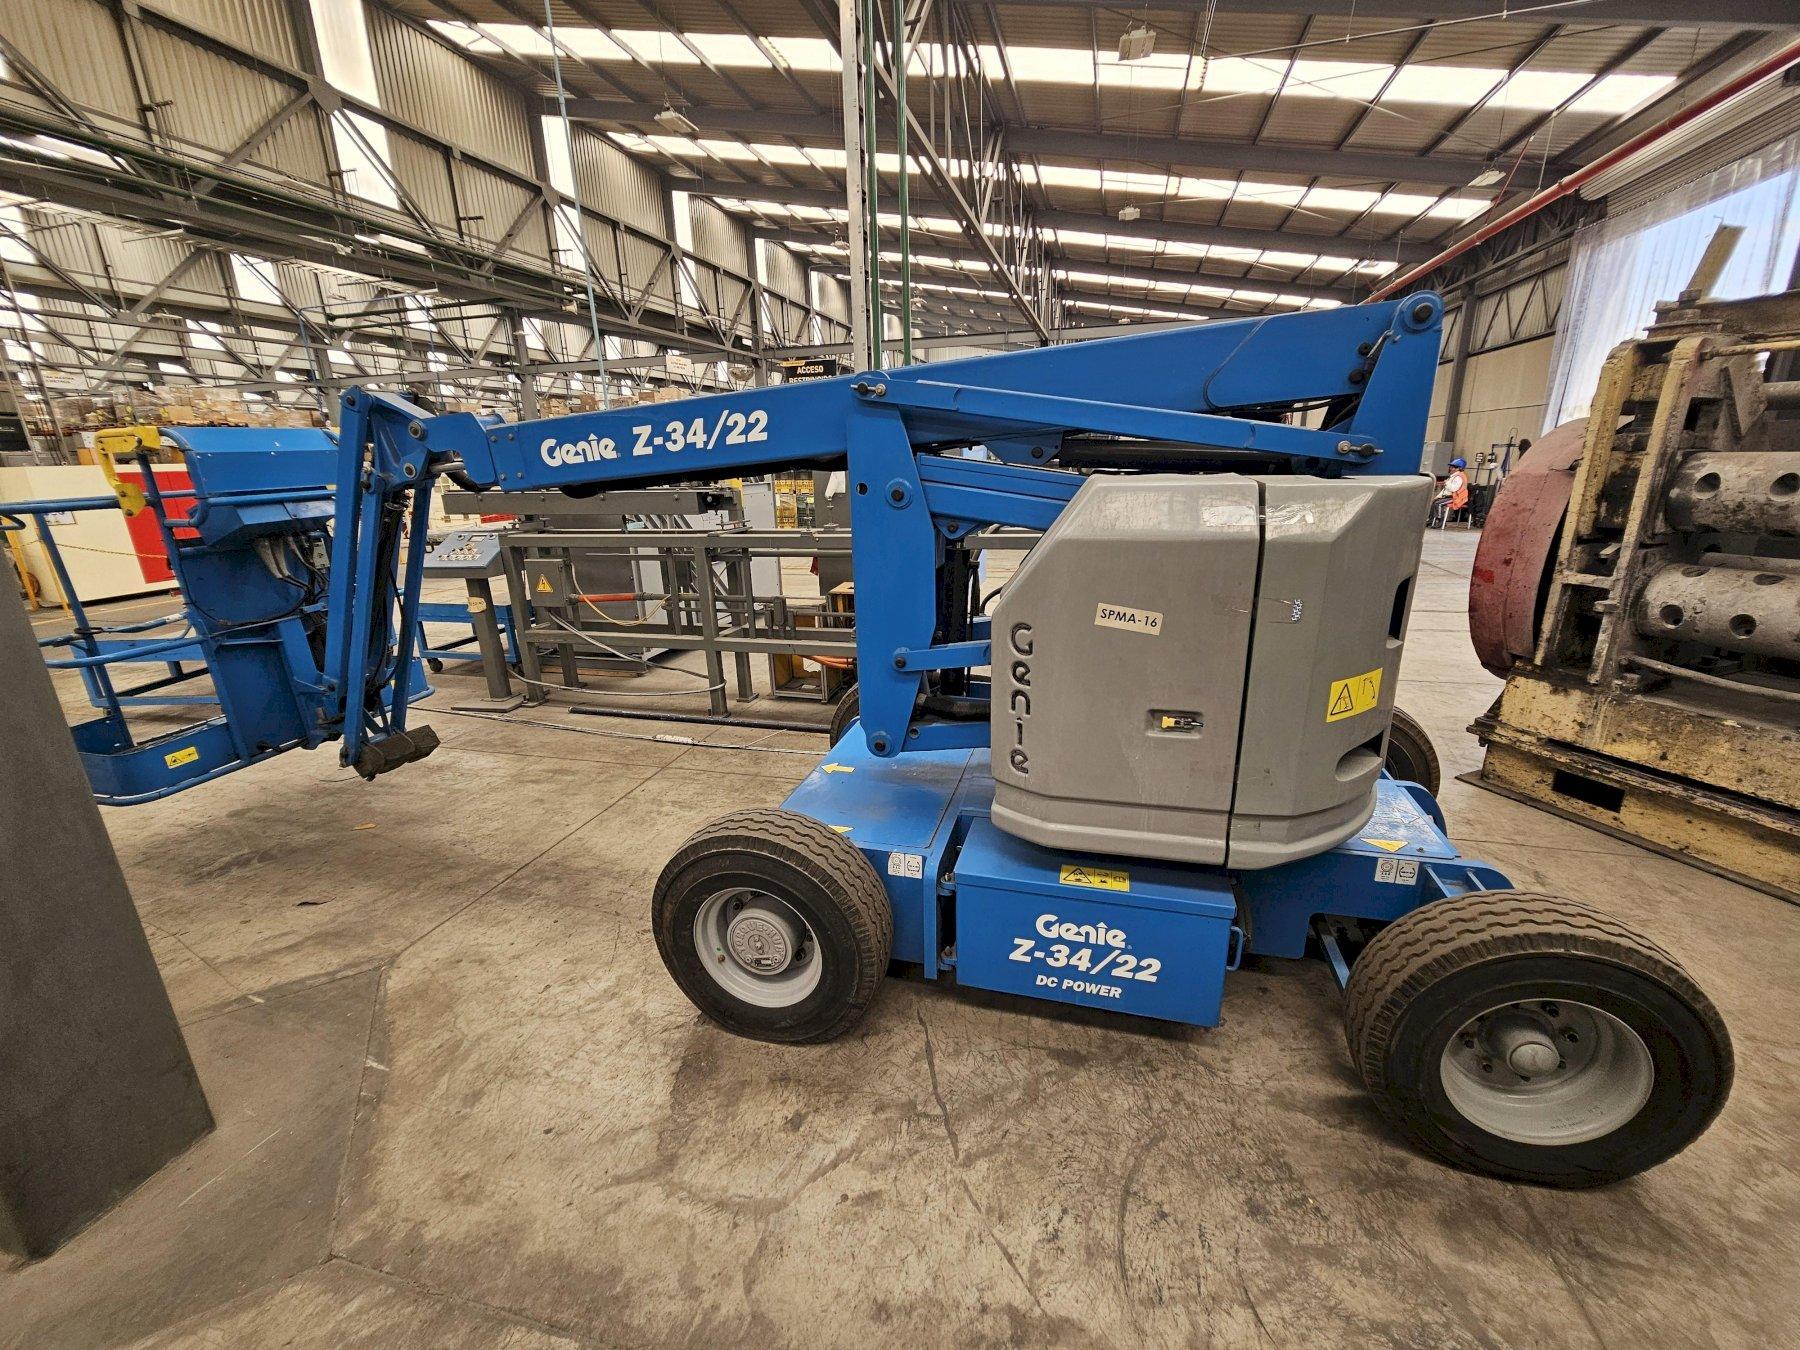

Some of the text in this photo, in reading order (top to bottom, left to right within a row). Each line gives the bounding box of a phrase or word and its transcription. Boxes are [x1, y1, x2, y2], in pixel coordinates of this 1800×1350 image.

[797, 365, 824, 374] ACCESO
[540, 410, 768, 467] Genie Z-34/22
[1100, 608, 1158, 628] SPMA-16
[1010, 622, 1034, 774] Genie
[1035, 914, 1127, 949] Genie
[1008, 938, 1162, 983] Z-34/22
[1035, 974, 1123, 999] DC POWER
